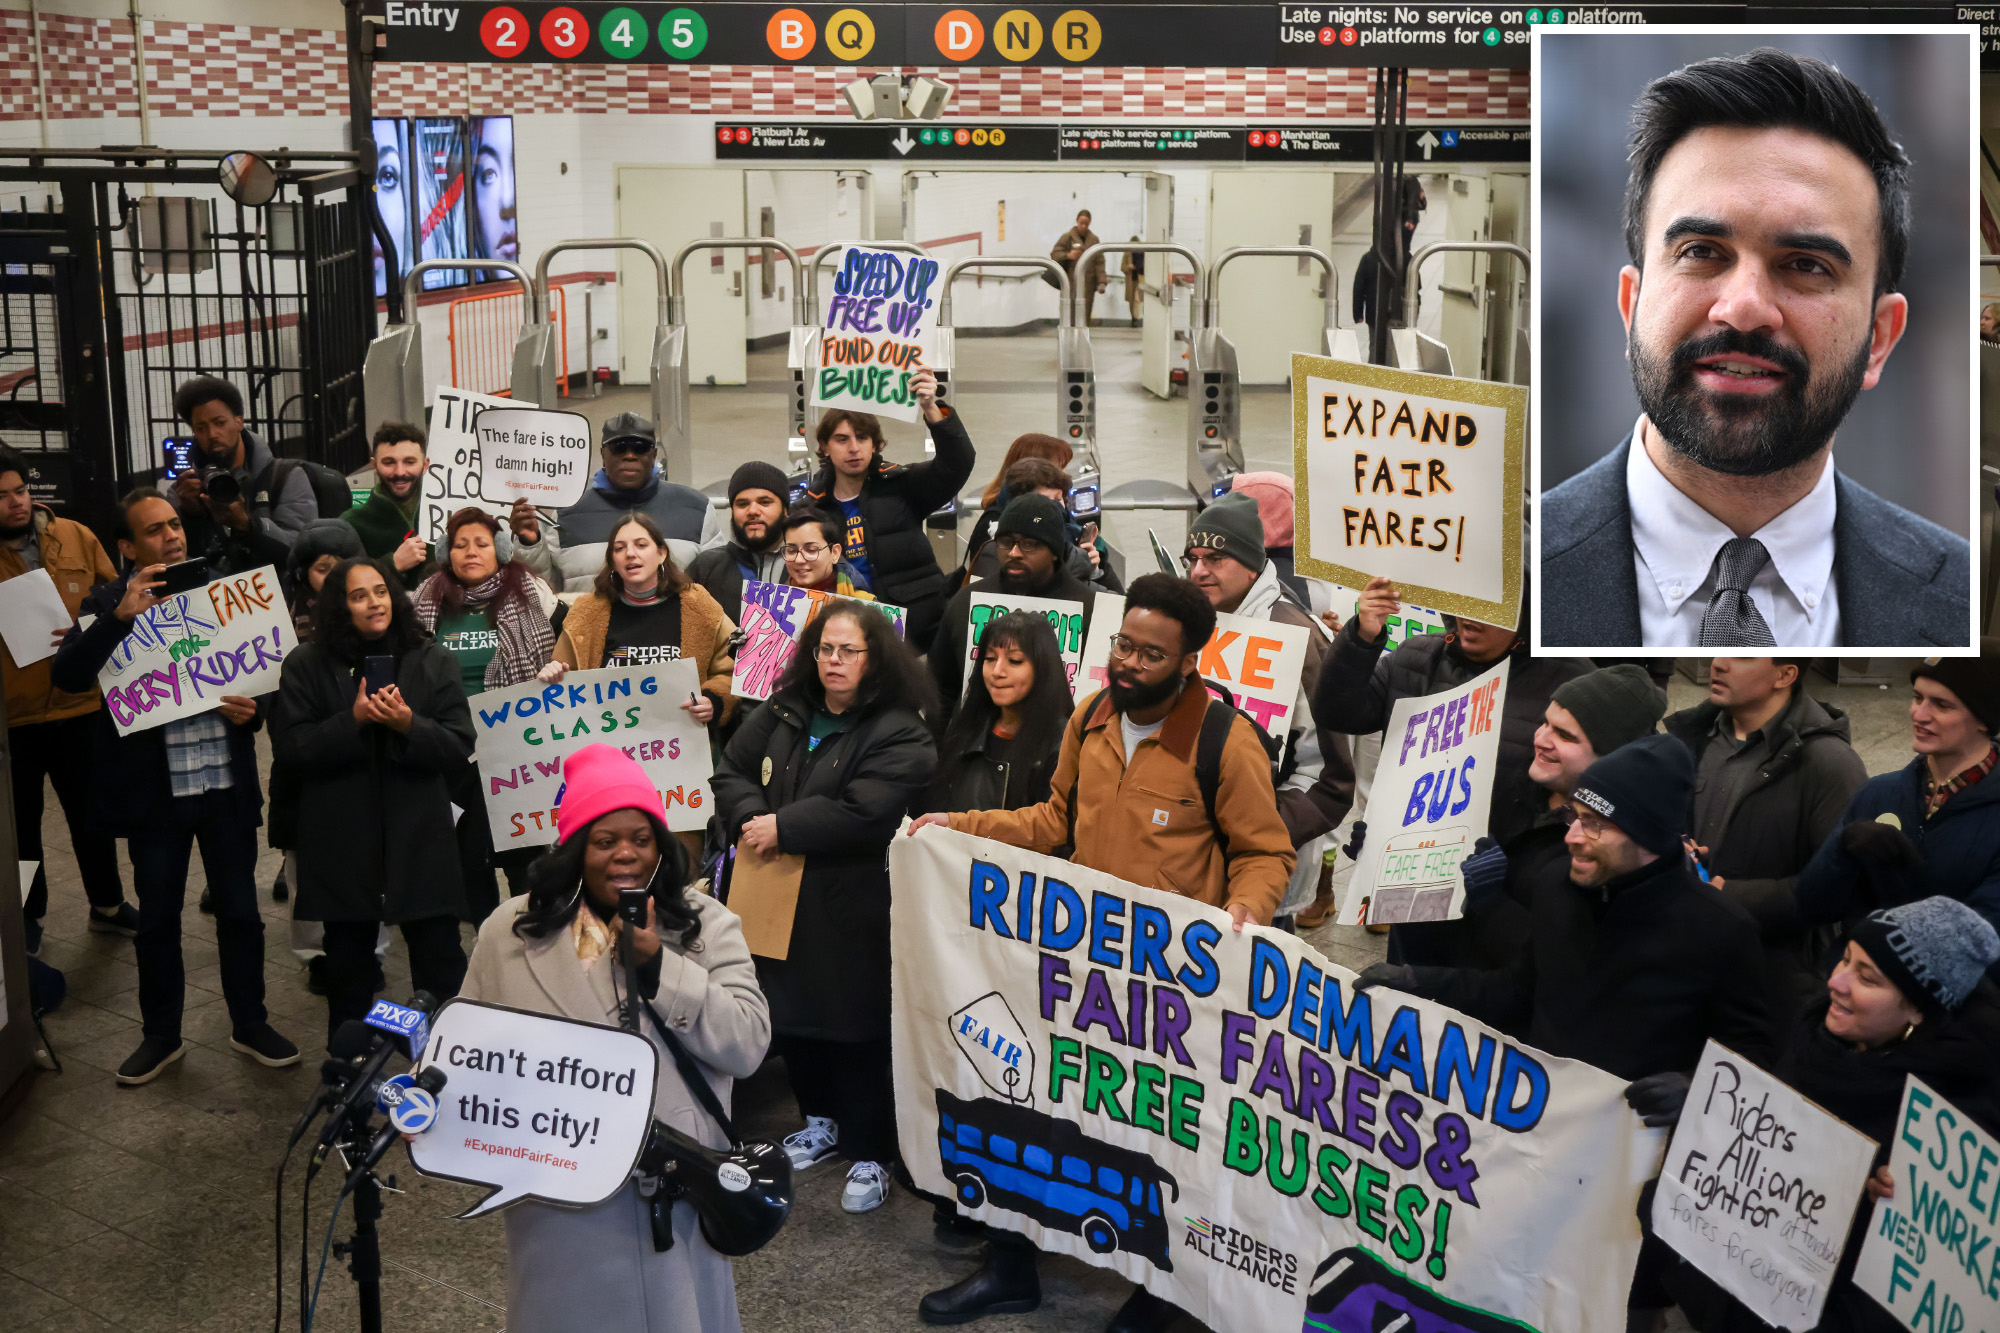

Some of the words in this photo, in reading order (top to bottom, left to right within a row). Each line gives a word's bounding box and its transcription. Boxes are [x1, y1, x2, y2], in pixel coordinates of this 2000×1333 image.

[386, 2, 459, 33] Entry
[1281, 8, 1321, 24] Late
[1328, 7, 1388, 26] nights:
[1394, 8, 1420, 24] No
[1427, 8, 1493, 24] service
[1500, 11, 1523, 24] on
[1567, 7, 1647, 24] platform.
[1957, 8, 1995, 20] Direct
[1981, 24, 2000, 35] str
[1280, 27, 1316, 43] Use
[1360, 27, 1446, 46] platforms
[1453, 27, 1480, 43] for
[752, 127, 794, 137] Flatbush
[796, 128, 808, 137] Av
[752, 137, 760, 147] &
[764, 137, 785, 146] New
[788, 137, 810, 146] Lots
[813, 137, 826, 147] Av
[1062, 130, 1080, 139] Late
[1083, 129, 1111, 140] nights:
[1112, 130, 1125, 139] No
[1127, 130, 1158, 139] service
[1194, 130, 1231, 140] platform.
[1062, 139, 1078, 148] Use
[1101, 139, 1140, 150] platforms
[1143, 139, 1156, 148] for
[1167, 140, 1198, 149] service
[1281, 131, 1330, 141] Manhattan
[1281, 140, 1289, 149] &
[1292, 140, 1310, 149] The
[1312, 140, 1340, 150] Bronx
[1459, 130, 1510, 140] Accessible
[834, 248, 904, 299] SPEED
[827, 295, 886, 333] FREE
[821, 335, 875, 368] FUND
[877, 339, 924, 372] OUR
[819, 365, 921, 407] BUSES!
[481, 428, 510, 444] The
[514, 429, 537, 446] fare
[541, 431, 554, 448] is
[560, 434, 586, 450] too
[1322, 392, 1478, 449] EXPAND
[495, 454, 528, 472] damn
[532, 457, 573, 477] high!
[1354, 450, 1455, 498] FAIR
[505, 480, 559, 492] #ExpandFairFares
[1187, 532, 1226, 550] NYC
[1341, 505, 1465, 563] FARES!
[208, 572, 274, 627] FARE
[743, 579, 807, 637] FREE
[169, 634, 211, 663] FOR
[105, 661, 182, 727] EVERY
[185, 625, 284, 699] RIDER!
[478, 676, 659, 729] WORKING
[1399, 692, 1470, 767] FREE
[1468, 676, 1501, 738] THE
[523, 706, 642, 746] CLASS
[490, 755, 561, 796] NEW
[1401, 755, 1476, 828] BUS
[1582, 788, 1615, 812] RIDERS
[1384, 853, 1422, 882] FARE
[1422, 848, 1461, 879] FREE
[969, 858, 1223, 998] RIDERS
[1248, 933, 1551, 1134] DEMAND
[1038, 954, 1198, 1068] FAIR
[958, 1013, 1023, 1068] FAIR
[431, 1035, 444, 1062] I
[449, 1043, 528, 1078] can't
[536, 1056, 637, 1097] afford
[382, 1085, 404, 1105] abc
[1704, 1061, 1797, 1153] Riders
[458, 1094, 521, 1129] this
[531, 1107, 601, 1149] city!
[464, 1138, 579, 1171] #ExpandFairFares
[1047, 1032, 1205, 1153] FREE
[1222, 1096, 1454, 1282] BUSES!
[719, 1173, 749, 1186] ALLIANCE
[1717, 1128, 1827, 1225] Alliance
[1211, 1223, 1298, 1274] RIDERS
[1670, 1193, 1719, 1243] fares
[1723, 1231, 1752, 1266] for
[1750, 1257, 1816, 1317] everyone!
[1879, 1207, 1927, 1265] NEED
[1184, 1230, 1298, 1296] ALLIANCE
